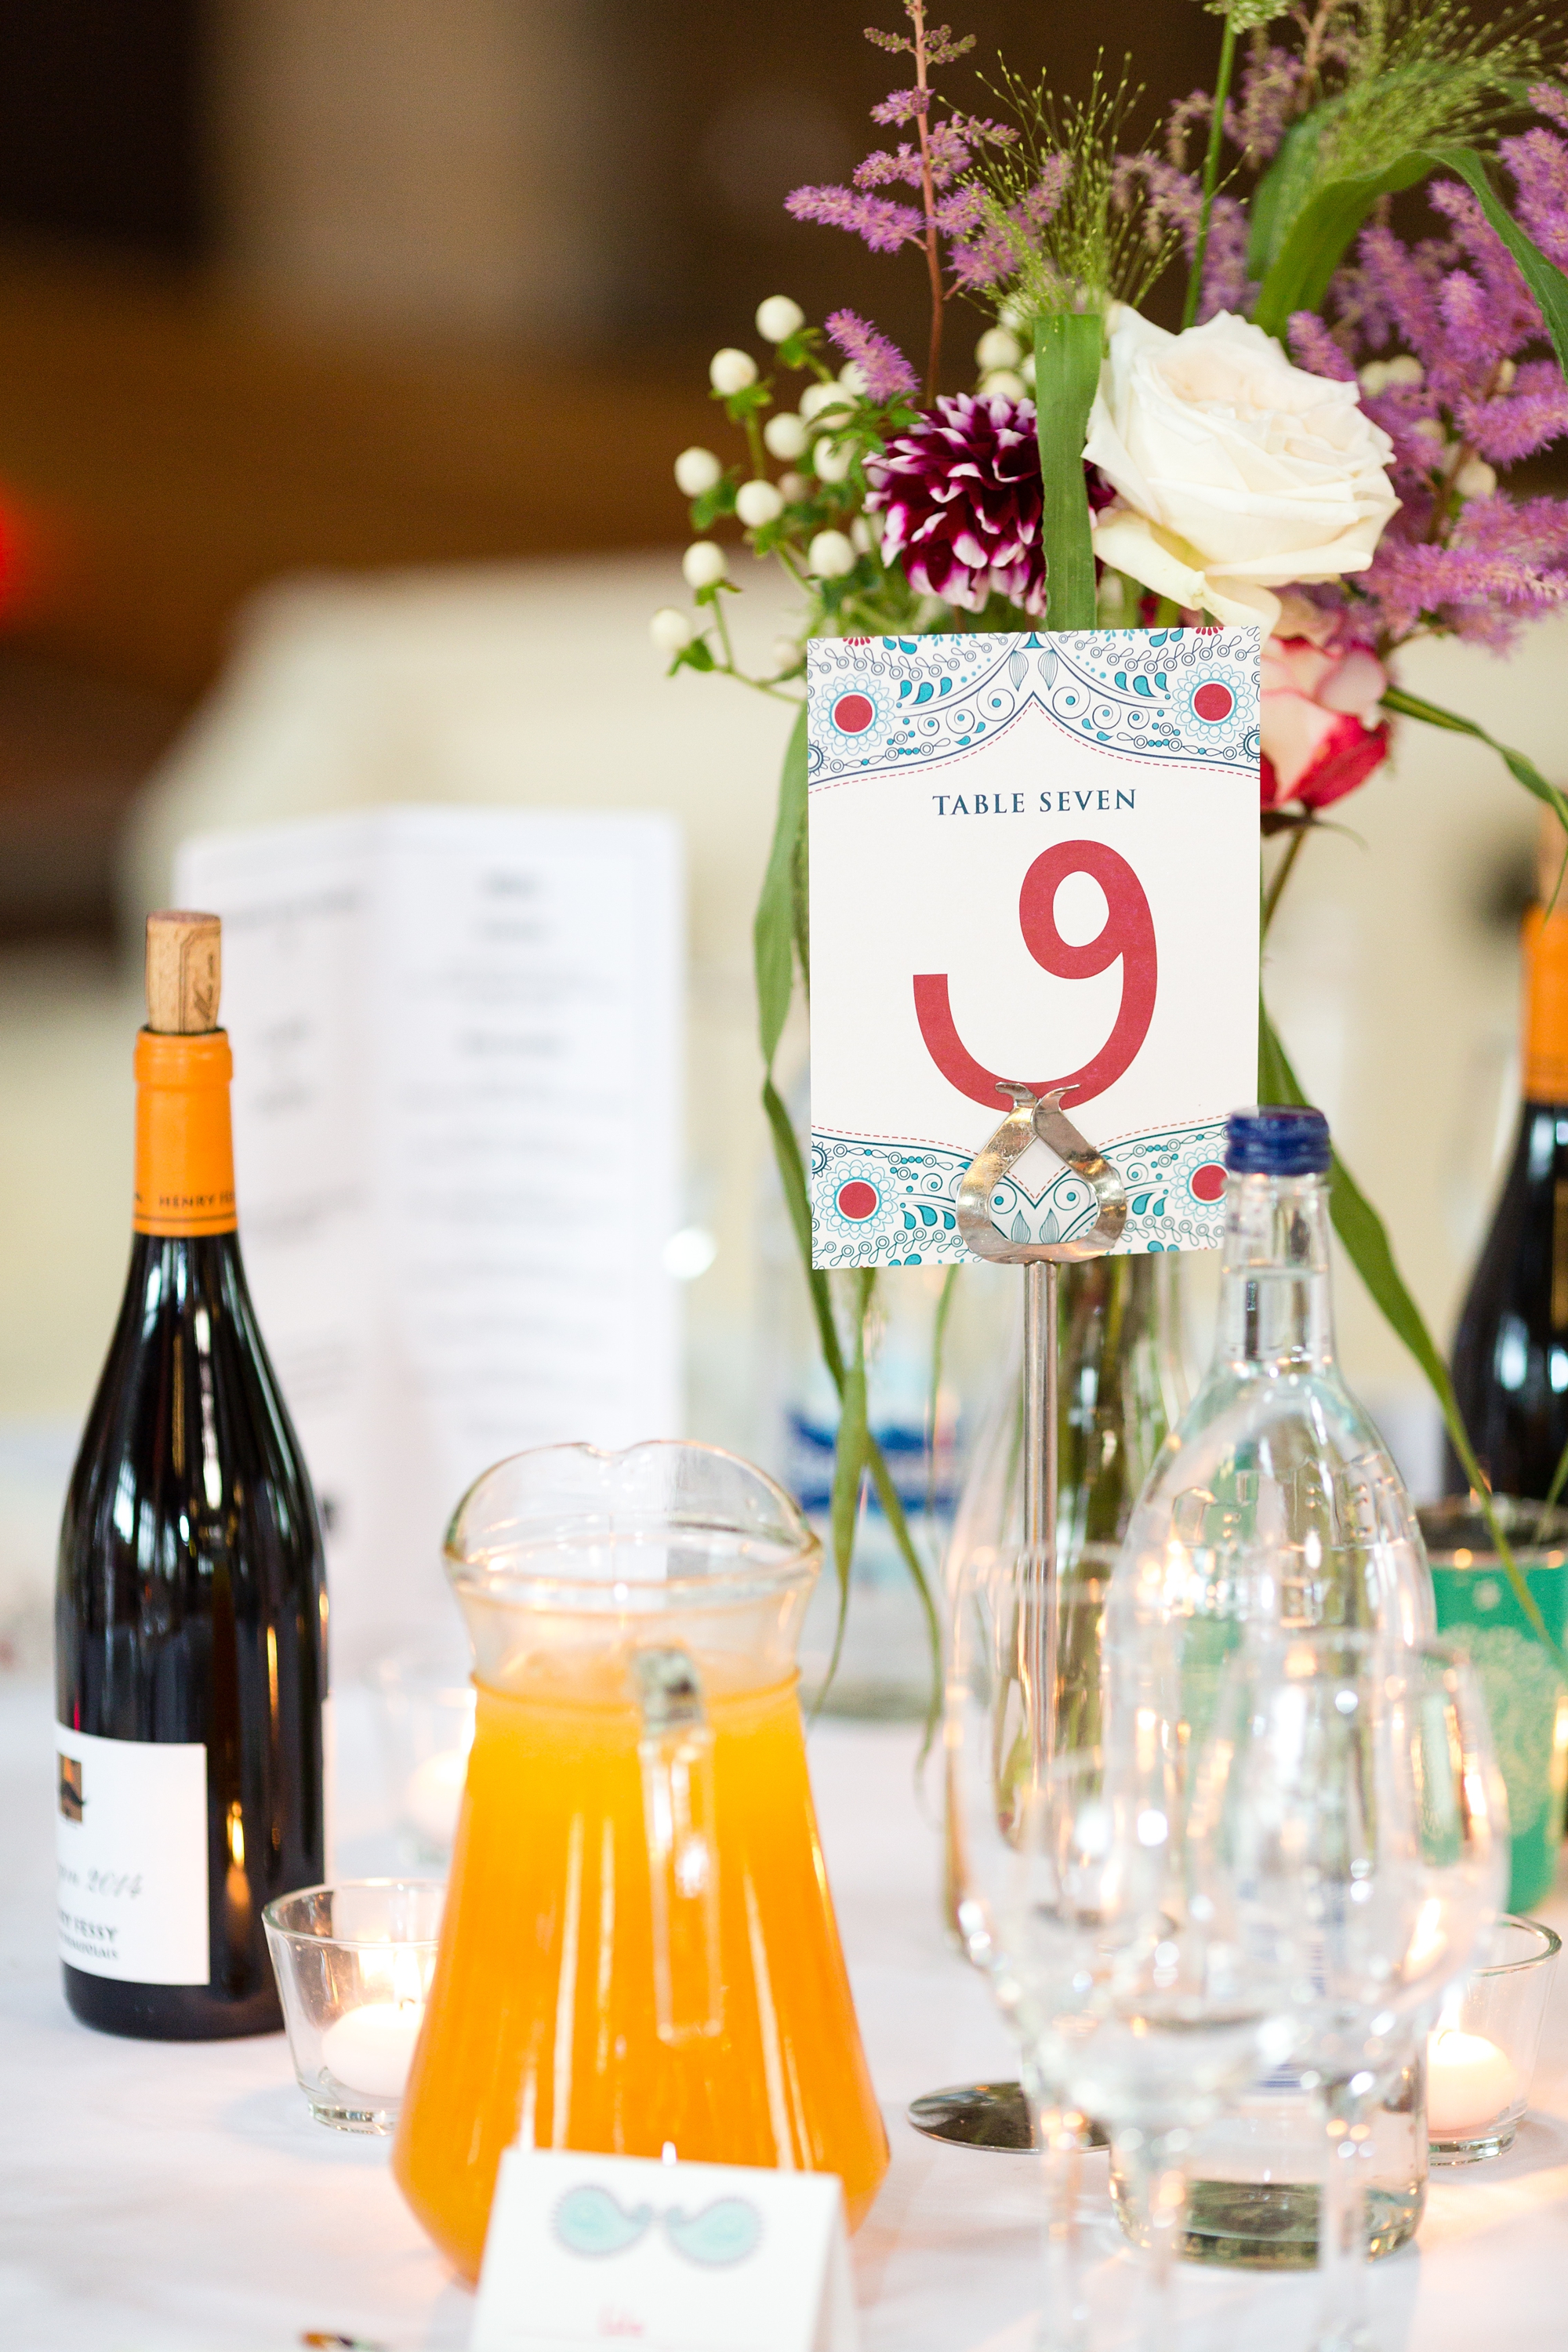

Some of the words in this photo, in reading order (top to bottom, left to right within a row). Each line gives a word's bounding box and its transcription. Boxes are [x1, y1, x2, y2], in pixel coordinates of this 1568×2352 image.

[932, 793, 1025, 815] TABLE
[1040, 789, 1136, 812] SEVEN
[159, 1193, 216, 1208] HENRY
